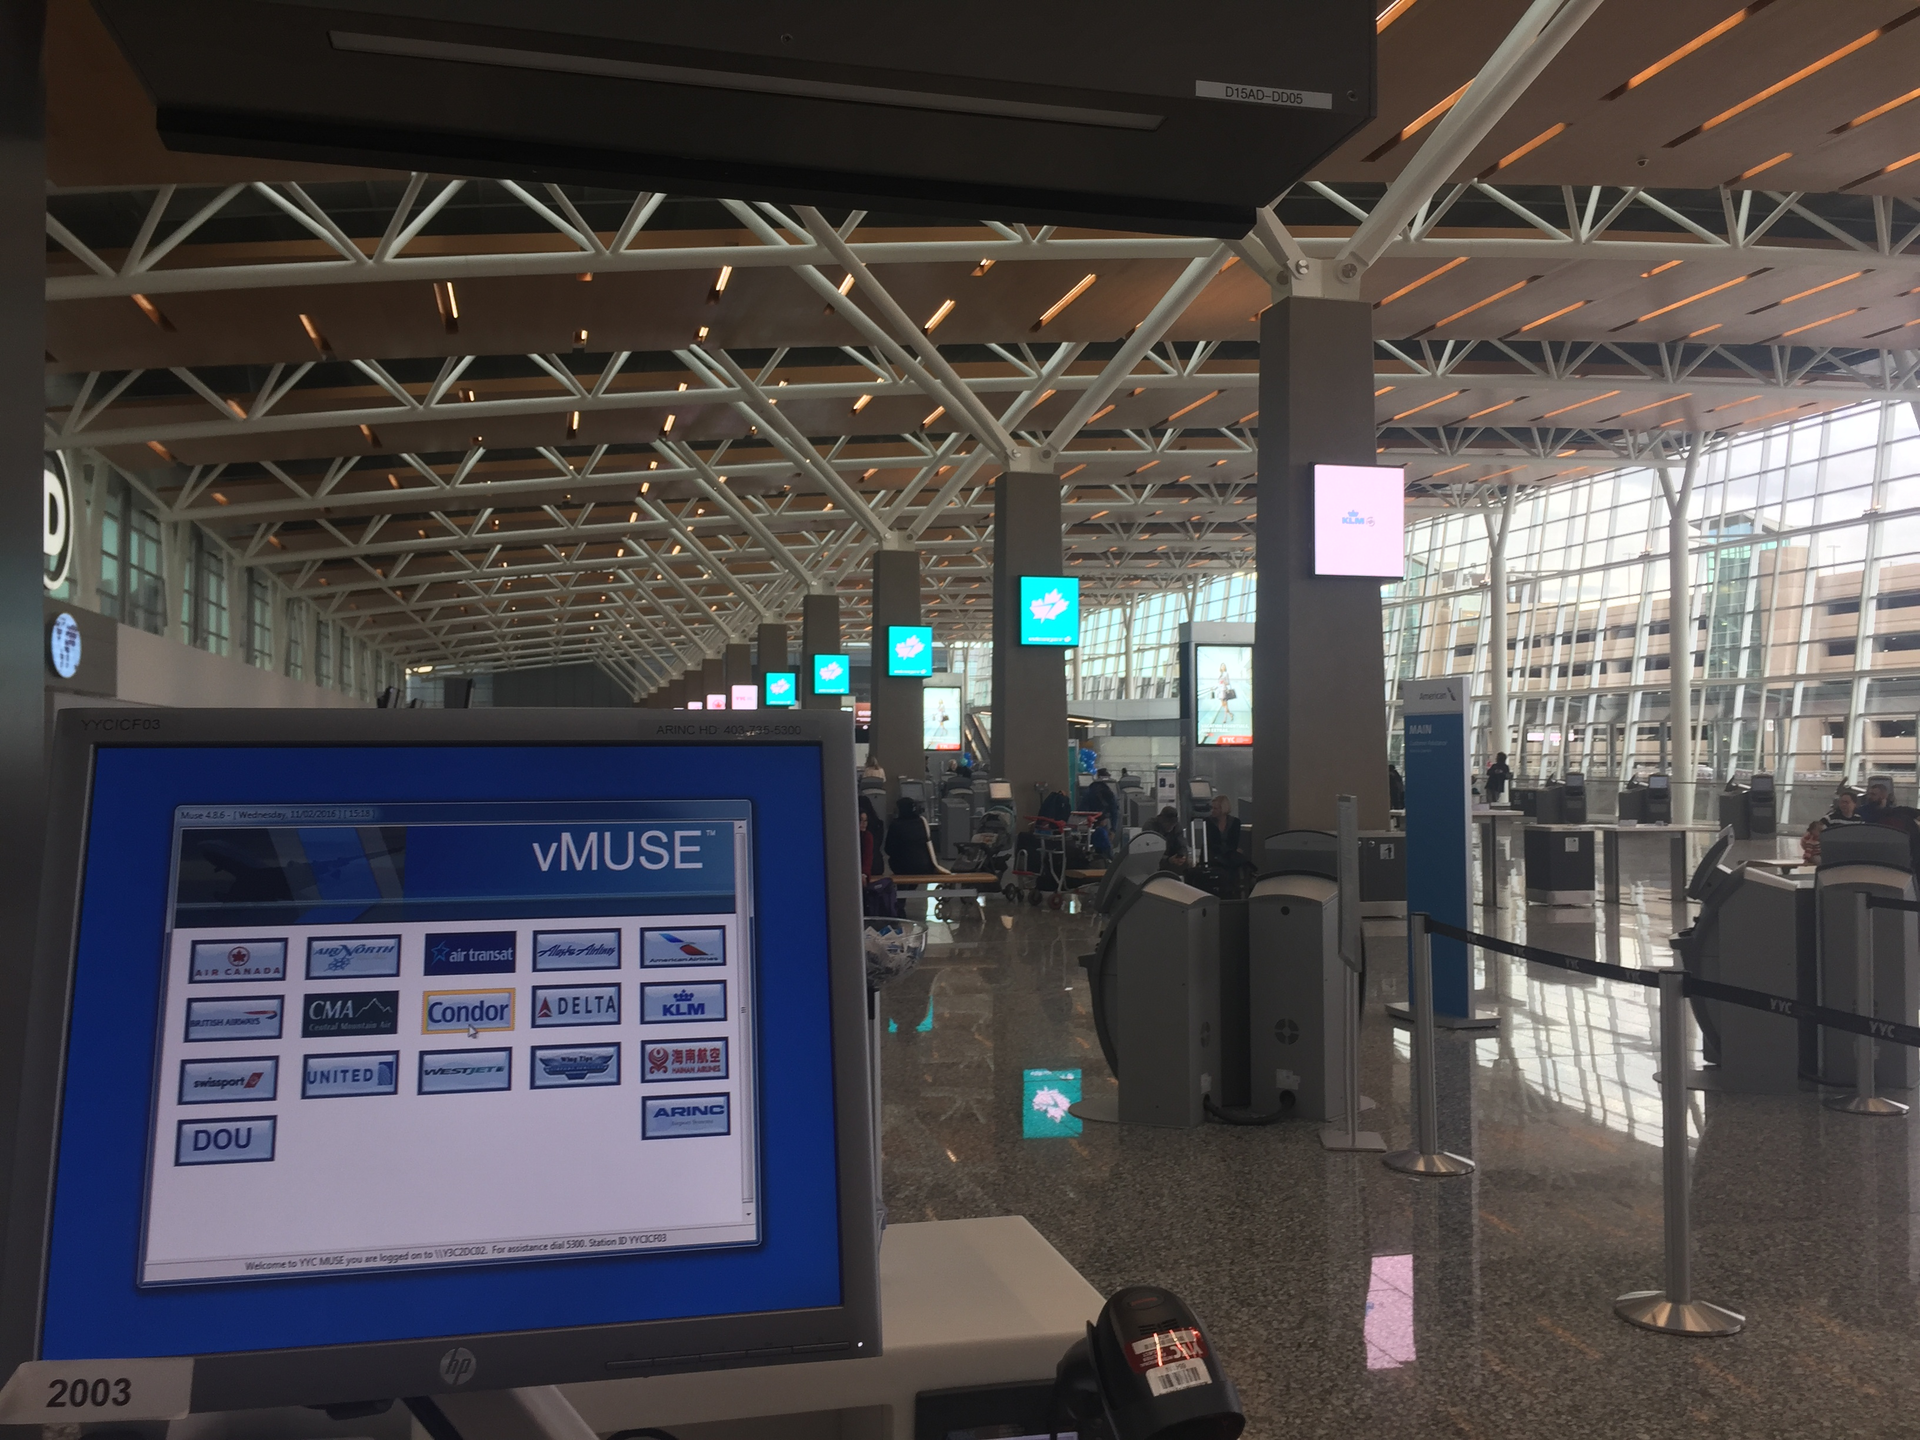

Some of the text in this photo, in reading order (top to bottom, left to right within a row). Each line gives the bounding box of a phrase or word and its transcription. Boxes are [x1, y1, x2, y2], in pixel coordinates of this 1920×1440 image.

[1225, 86, 1303, 105] D15AD-DD05
[1342, 517, 1365, 525] KLM
[81, 718, 161, 732] YYCICF03
[656, 724, 696, 736] ARINC
[723, 723, 801, 736] 403-735-5300
[1409, 724, 1432, 735] MAIN
[181, 811, 203, 820] Muse
[239, 809, 289, 820] Wednesday,
[291, 808, 337, 818] 11/02/2016
[532, 830, 704, 872] vMUSE
[449, 946, 513, 963] air transat
[194, 966, 281, 977] AIR CANADA
[309, 1000, 354, 1020] CMA
[428, 1001, 509, 1024] Condor
[557, 995, 617, 1016] DELTA
[662, 1003, 706, 1017] KLM
[1770, 998, 1793, 1014] YYC
[190, 1016, 261, 1028] BRITISH AIRWAYS
[309, 1021, 392, 1032] Central Mountain Air
[1868, 1020, 1896, 1038] YYC
[671, 1047, 721, 1066] 海南航空
[307, 1068, 373, 1085] UNITED
[424, 1066, 497, 1076] WESTJET
[672, 1065, 721, 1074] HAINAN AIRLINES
[193, 1076, 245, 1090] swissport
[653, 1104, 725, 1119] ARINC
[193, 1127, 252, 1151] DOU
[244, 1260, 287, 1271] Welcome
[288, 1260, 298, 1268] to
[299, 1257, 317, 1267] YYC
[320, 1255, 345, 1266] MUSE
[346, 1256, 363, 1267] you
[365, 1254, 378, 1263] are
[379, 1250, 409, 1264] logged
[410, 1250, 422, 1260] on
[424, 1250, 433, 1259] to
[492, 1244, 506, 1255] For
[507, 1242, 549, 1253] assistance
[550, 1240, 565, 1250] dial
[566, 1238, 587, 1249] 5300.
[589, 1237, 617, 1247] Station
[618, 1235, 628, 1245] ID
[629, 1233, 667, 1244] YYCICF03
[446, 1351, 470, 1379] hp
[46, 1377, 132, 1408] 2003
